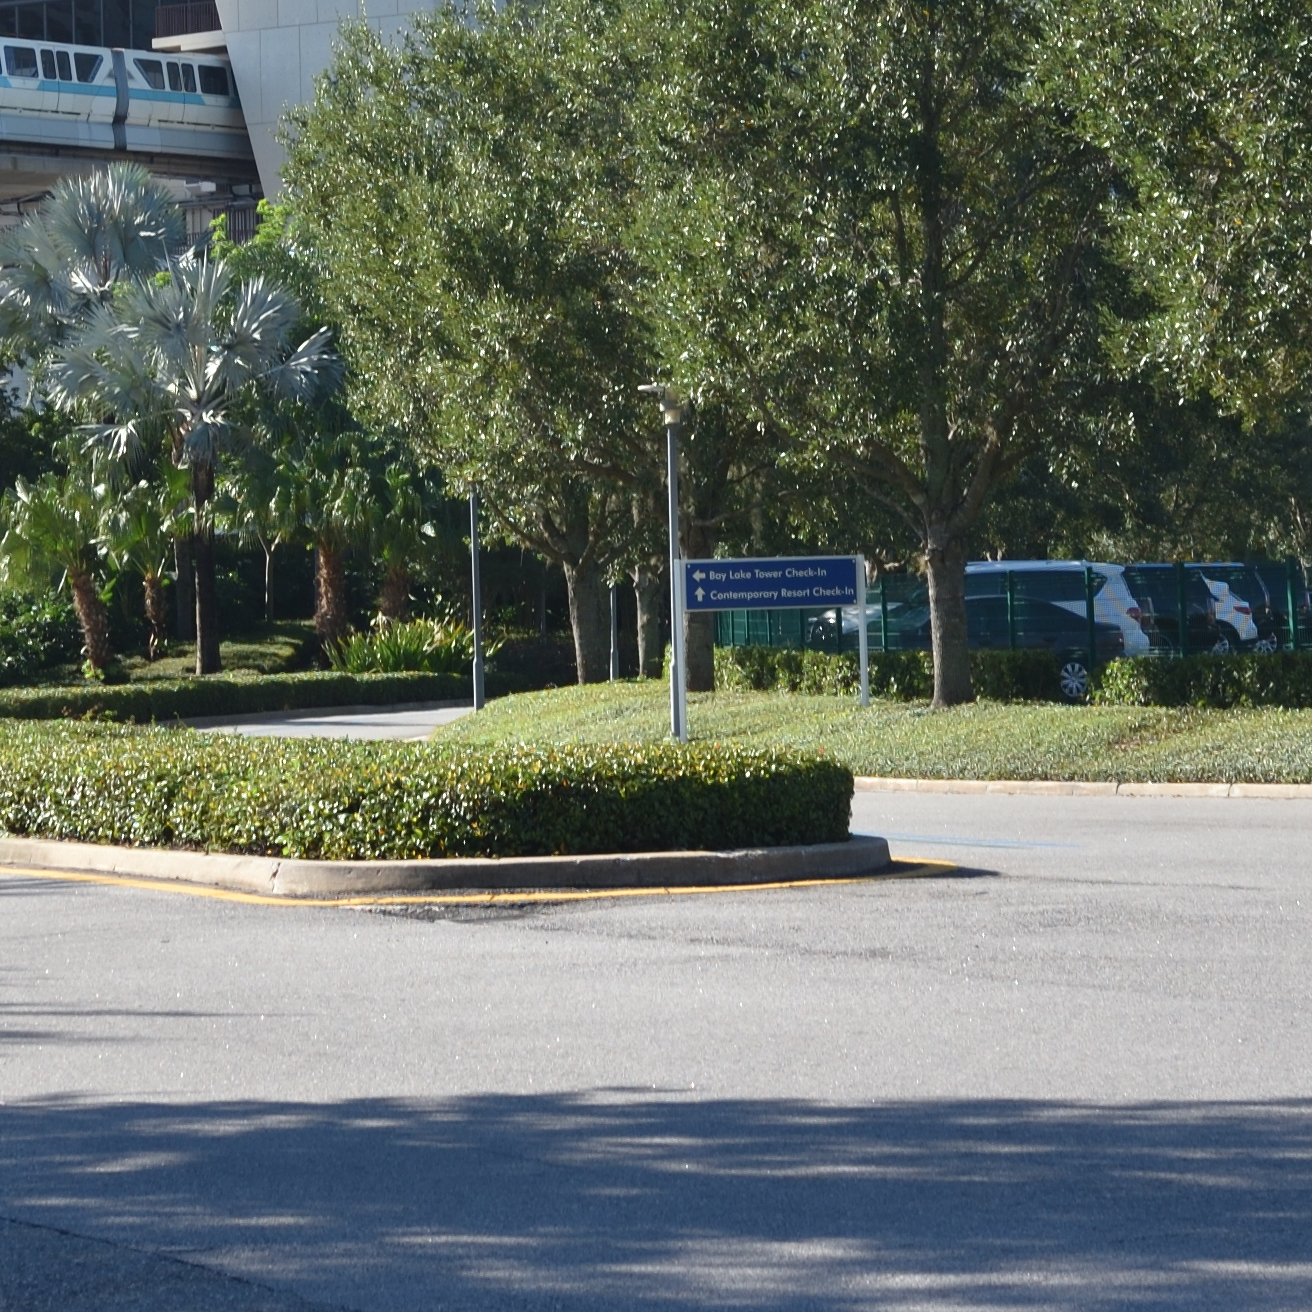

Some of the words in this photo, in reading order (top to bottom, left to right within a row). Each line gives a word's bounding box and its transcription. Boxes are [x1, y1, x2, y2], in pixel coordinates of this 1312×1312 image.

[709, 570, 726, 582] Bay
[729, 569, 752, 580] Lake
[754, 568, 783, 579] Tower
[785, 566, 827, 577] Check-In
[710, 590, 778, 601] Contemporary
[781, 588, 810, 598] Resort
[812, 586, 855, 597] Check-In
